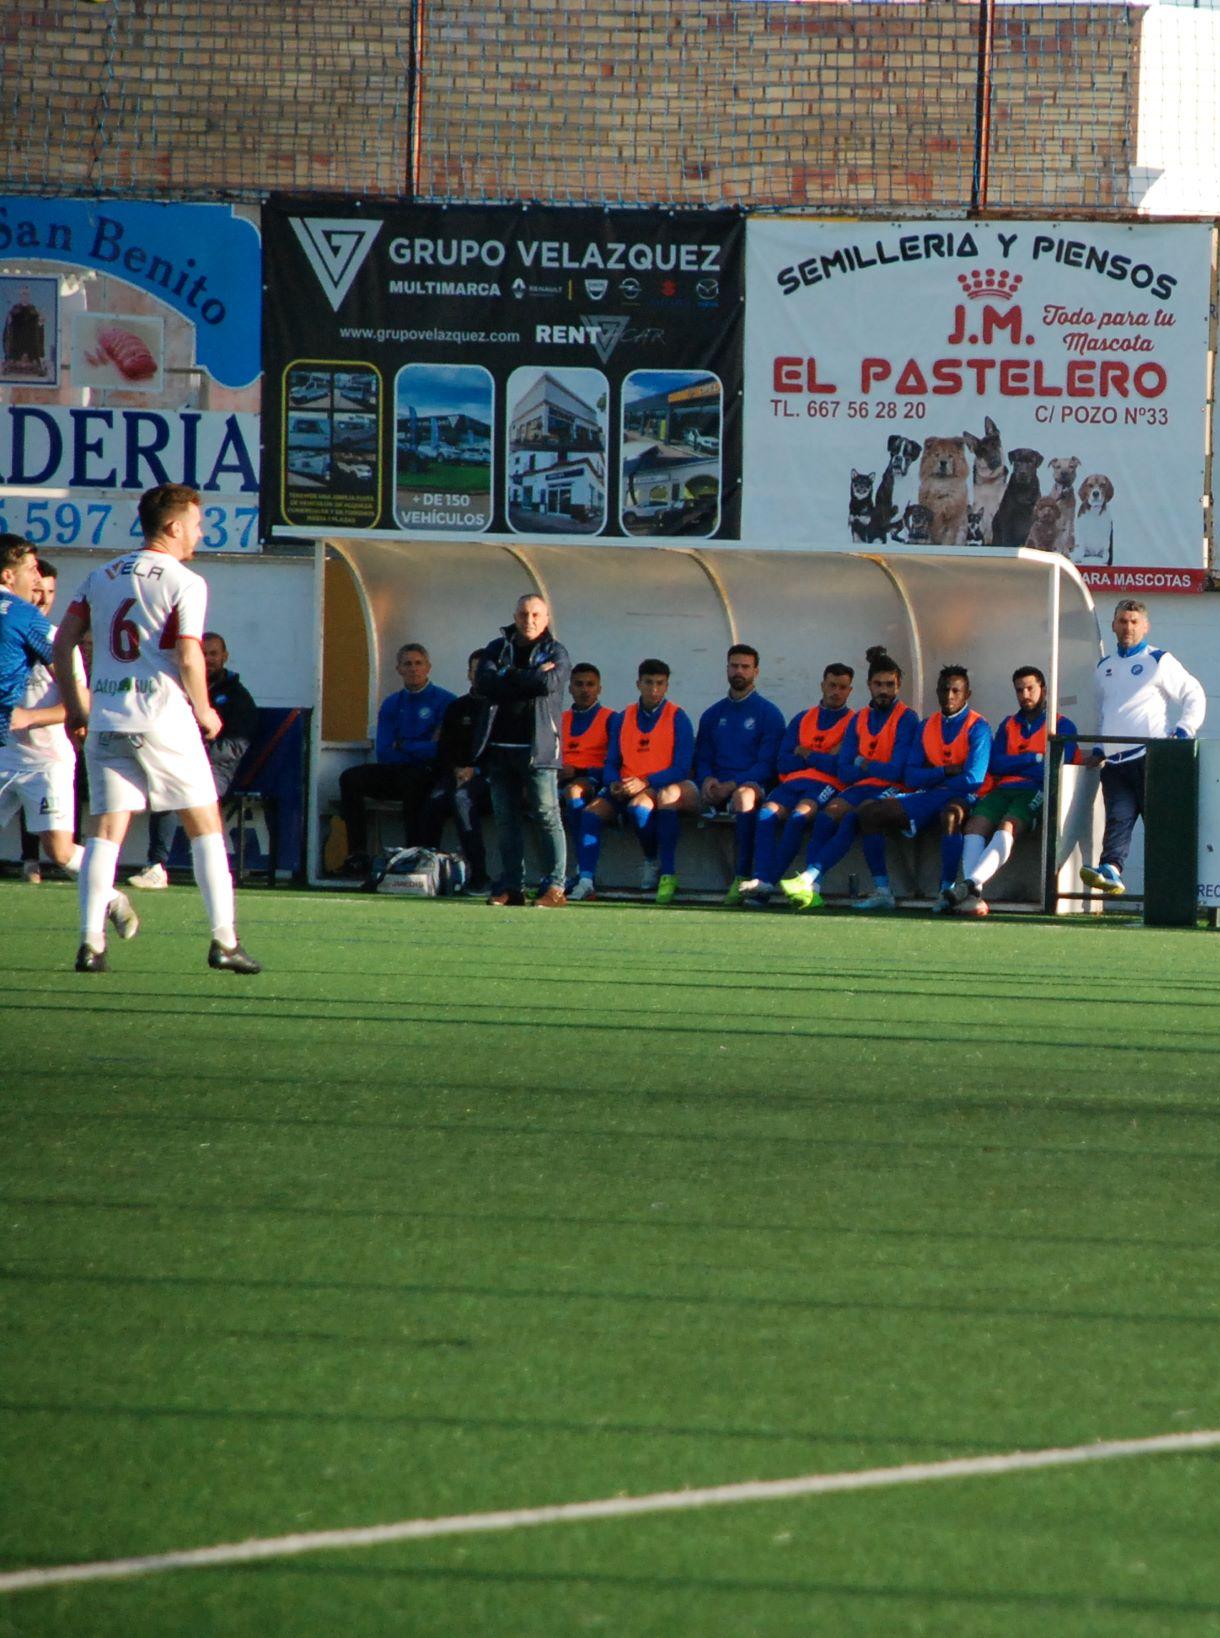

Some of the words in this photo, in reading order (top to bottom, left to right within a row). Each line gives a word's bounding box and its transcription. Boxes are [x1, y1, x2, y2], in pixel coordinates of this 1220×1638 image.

[389, 238, 505, 267] GRUPO
[517, 240, 721, 272] VELAZQUEZ
[777, 231, 979, 296] SEMILLERIA
[998, 233, 1018, 258] Y
[1032, 236, 1178, 300] PIENSOS
[89, 216, 226, 325] Benito
[389, 281, 501, 297] MULTIMARCA
[948, 304, 1036, 345] J.M.
[1042, 304, 1096, 326] Todo
[1096, 310, 1150, 330] para
[1153, 309, 1177, 327] tu
[340, 327, 520, 344] www.grupovelazquez.com
[536, 324, 602, 344] RENT
[1062, 332, 1156, 355] Mascota
[773, 356, 837, 394] EL
[861, 358, 1168, 398] PASTELERO
[770, 400, 800, 417] TL.
[807, 400, 840, 418] 667
[847, 401, 869, 418] 56
[875, 401, 898, 419] 28
[903, 401, 926, 419] 20
[1035, 405, 1055, 424] C/
[1061, 406, 1117, 425] POZO
[0, 407, 260, 492] DERIA
[423, 493, 443, 507] DE
[444, 494, 470, 507] 150
[25, 502, 113, 545] 597
[401, 509, 485, 526] VEHÍCULOS
[1080, 572, 1111, 585] ARA
[1114, 573, 1191, 587] MASCOTAS
[110, 598, 141, 663] 6
